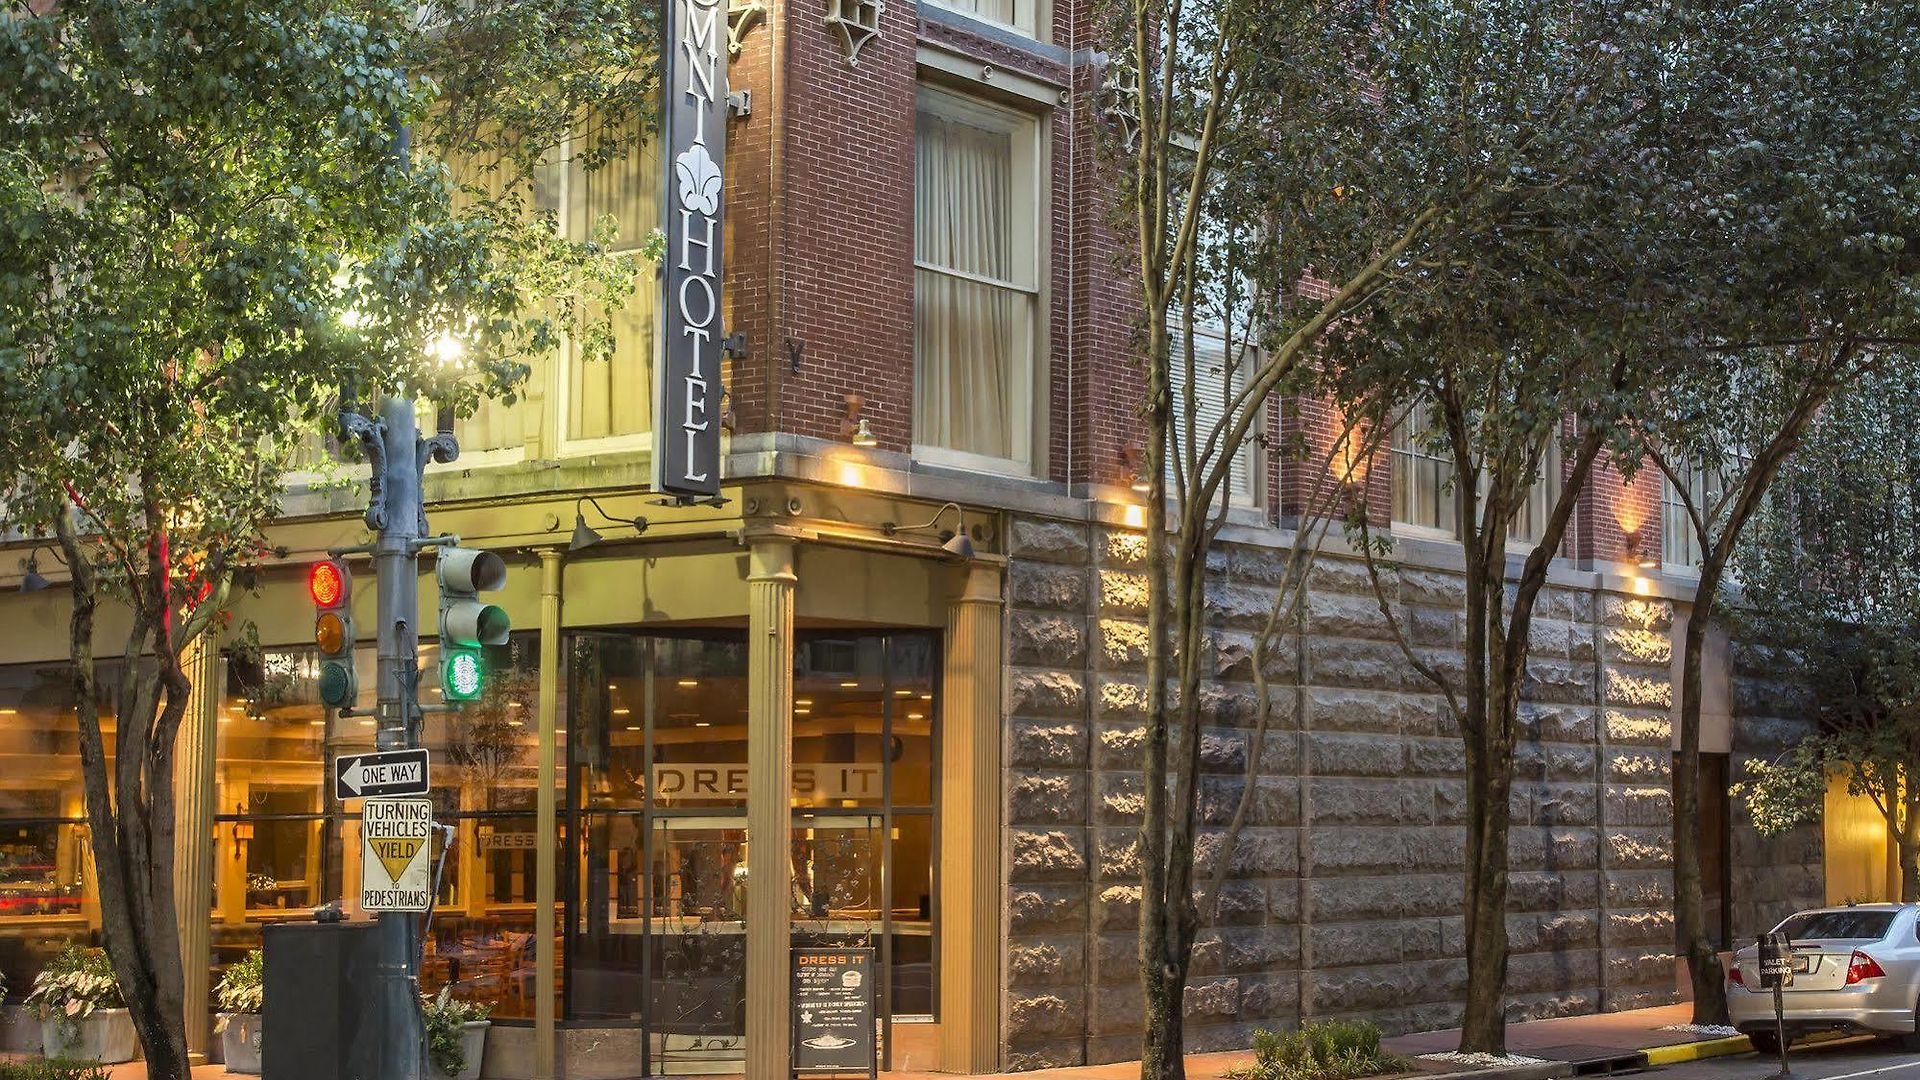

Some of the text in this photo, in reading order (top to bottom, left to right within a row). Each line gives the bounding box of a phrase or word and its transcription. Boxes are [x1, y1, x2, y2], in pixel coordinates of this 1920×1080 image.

[677, 0, 720, 482] MNI HOTEL
[362, 764, 417, 784] ONE WAY
[657, 769, 878, 793] DRES IT
[367, 803, 428, 820] TURNING
[366, 821, 428, 837] VEHICLES
[378, 842, 414, 859] YIELD
[391, 882, 400, 890] TO
[364, 890, 427, 907] PEDESTRIANS
[799, 955, 865, 965] DRESS IT
[1763, 958, 1786, 966] VALET
[1760, 967, 1791, 975] PARKING
